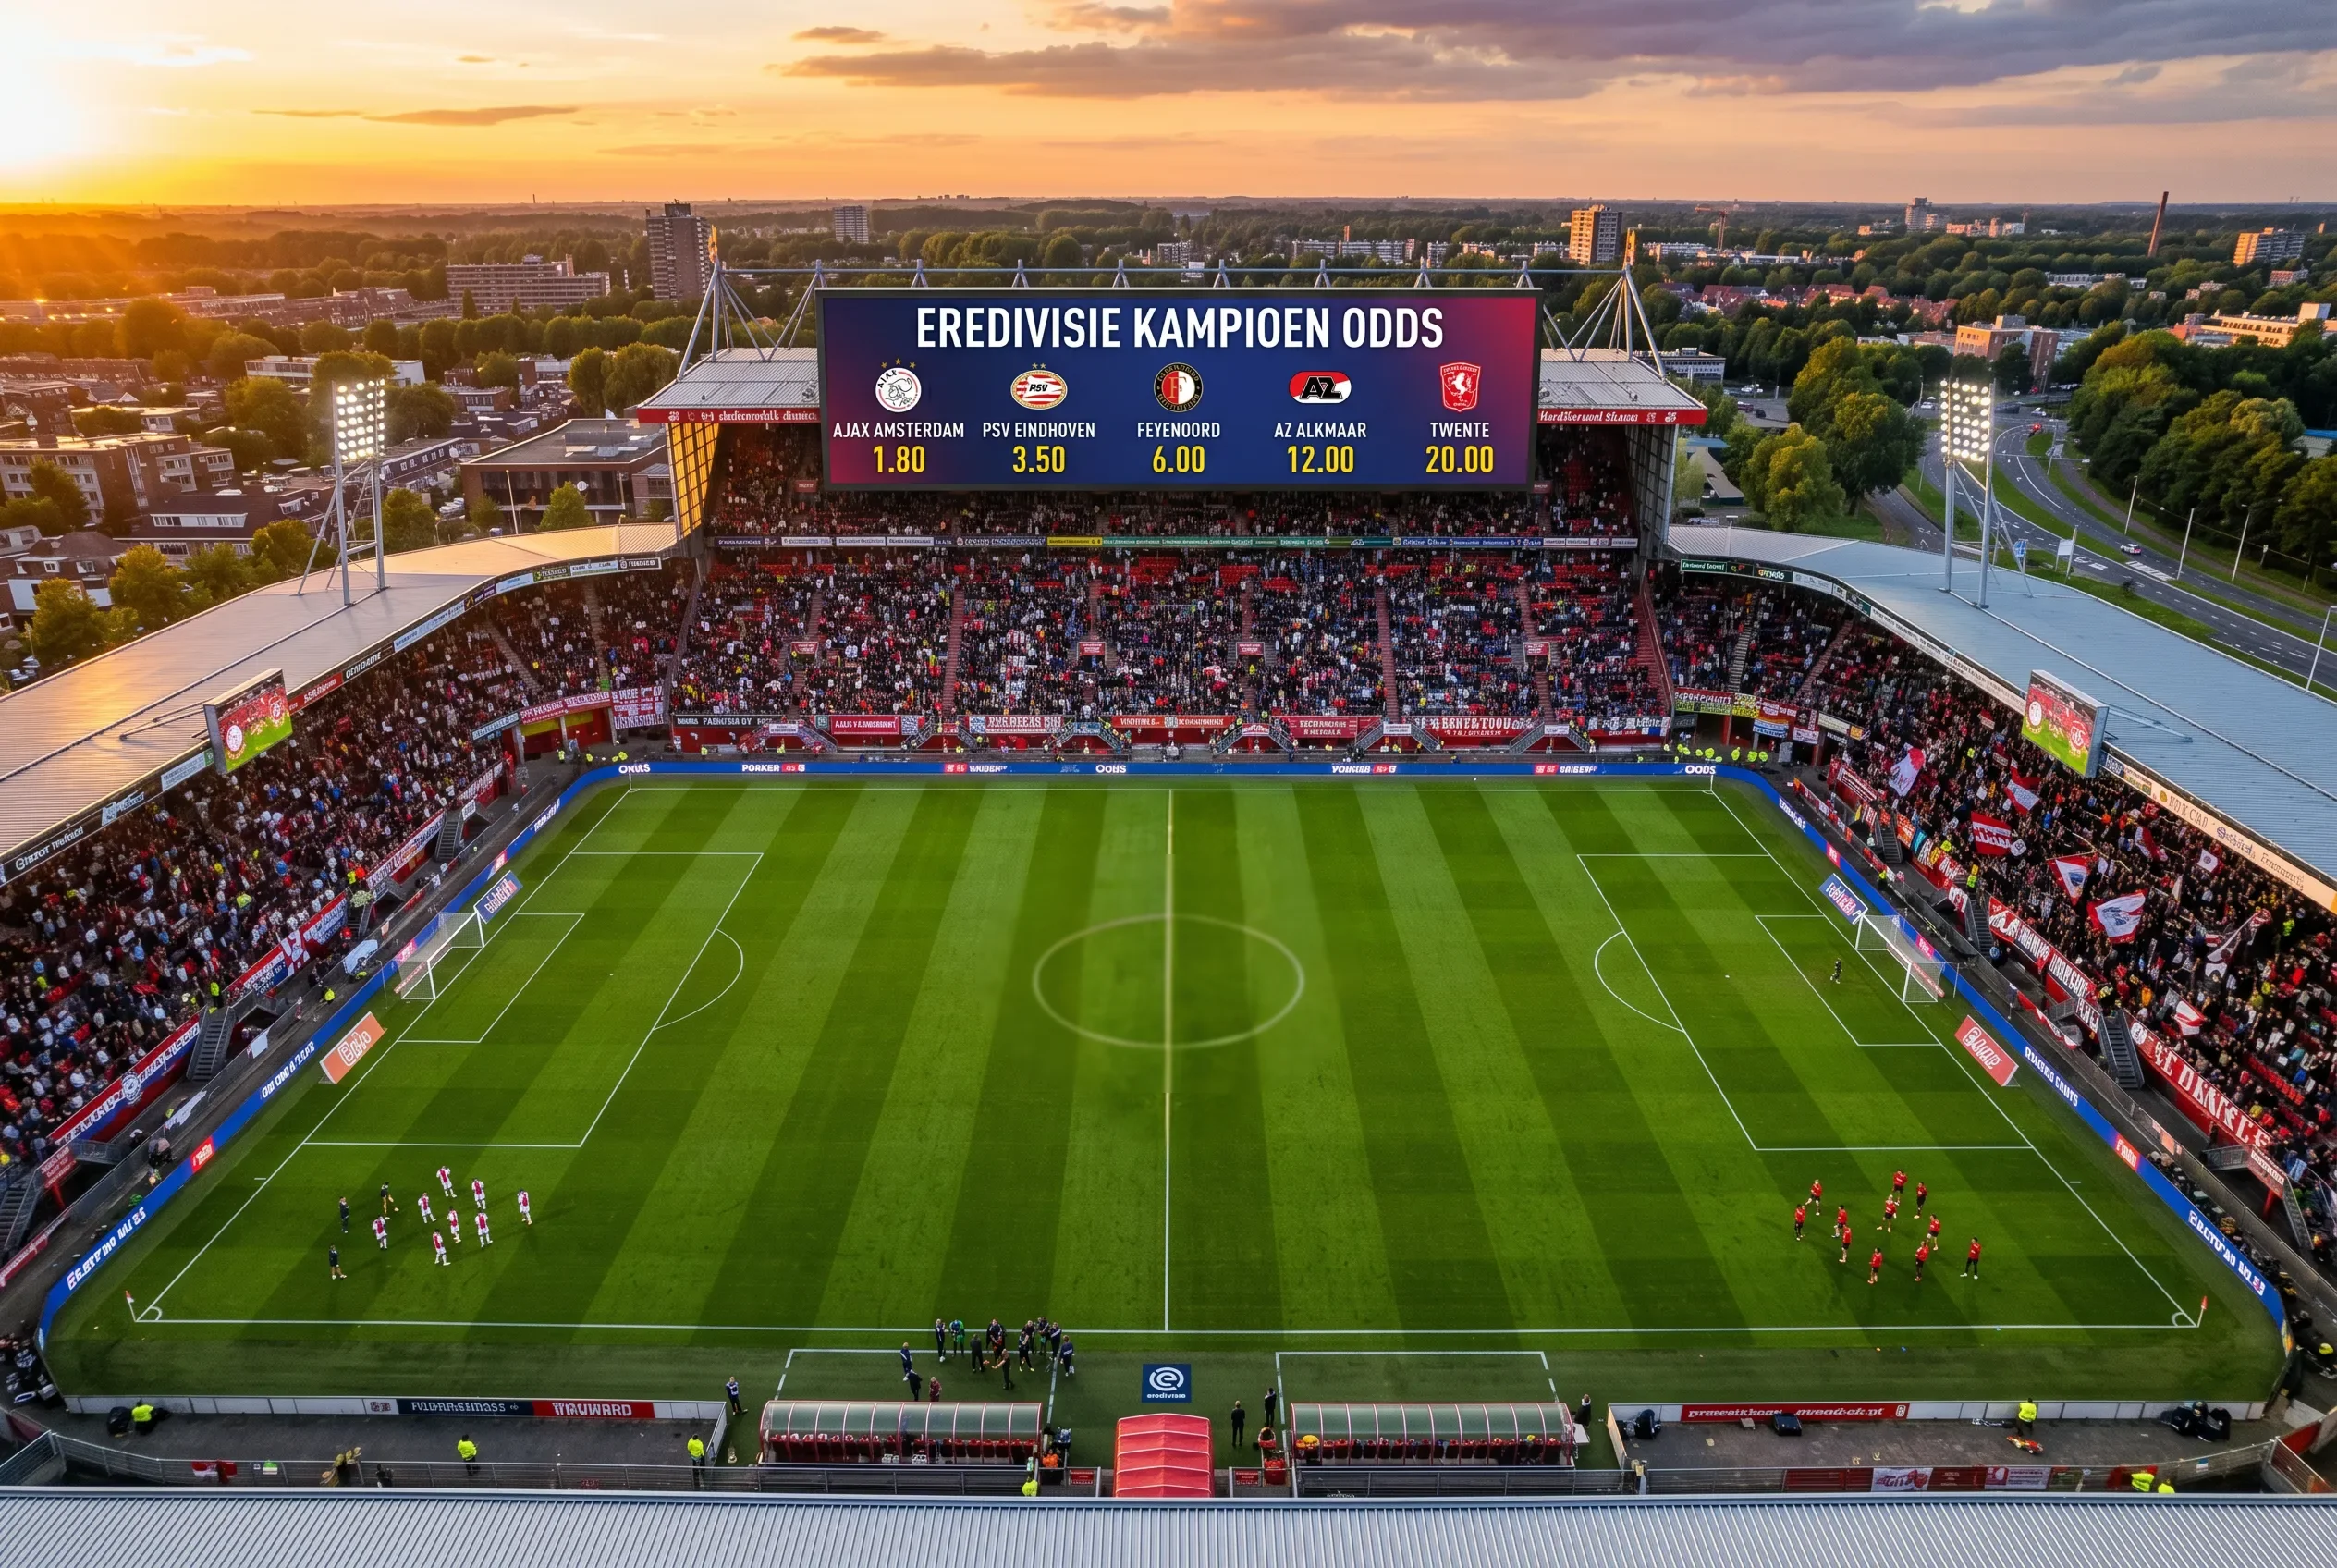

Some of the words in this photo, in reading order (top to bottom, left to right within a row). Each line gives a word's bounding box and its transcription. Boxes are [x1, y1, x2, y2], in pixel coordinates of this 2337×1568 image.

[916, 307, 1121, 349] EREDIVISIE
[1133, 307, 1330, 349] KAMPIOEN
[1342, 307, 1444, 349] ODDS
[1029, 383, 1048, 393] PSV
[1299, 375, 1343, 400] AZ
[833, 422, 870, 438] AJAX
[874, 422, 964, 438] AMSTERDAM
[983, 422, 1010, 438] PSV
[1015, 422, 1095, 438] EINDHOVEN
[1137, 422, 1221, 438] FEYENOORD
[1274, 422, 1292, 438] AZ
[1296, 422, 1367, 438] ALKMAAR
[1430, 422, 1490, 438] TWENTE
[873, 445, 925, 473] 1.80
[1012, 445, 1065, 473] 3.50
[1152, 445, 1205, 473] 6.00
[1287, 445, 1354, 473] 12.00
[1425, 445, 1494, 473] 20.00
